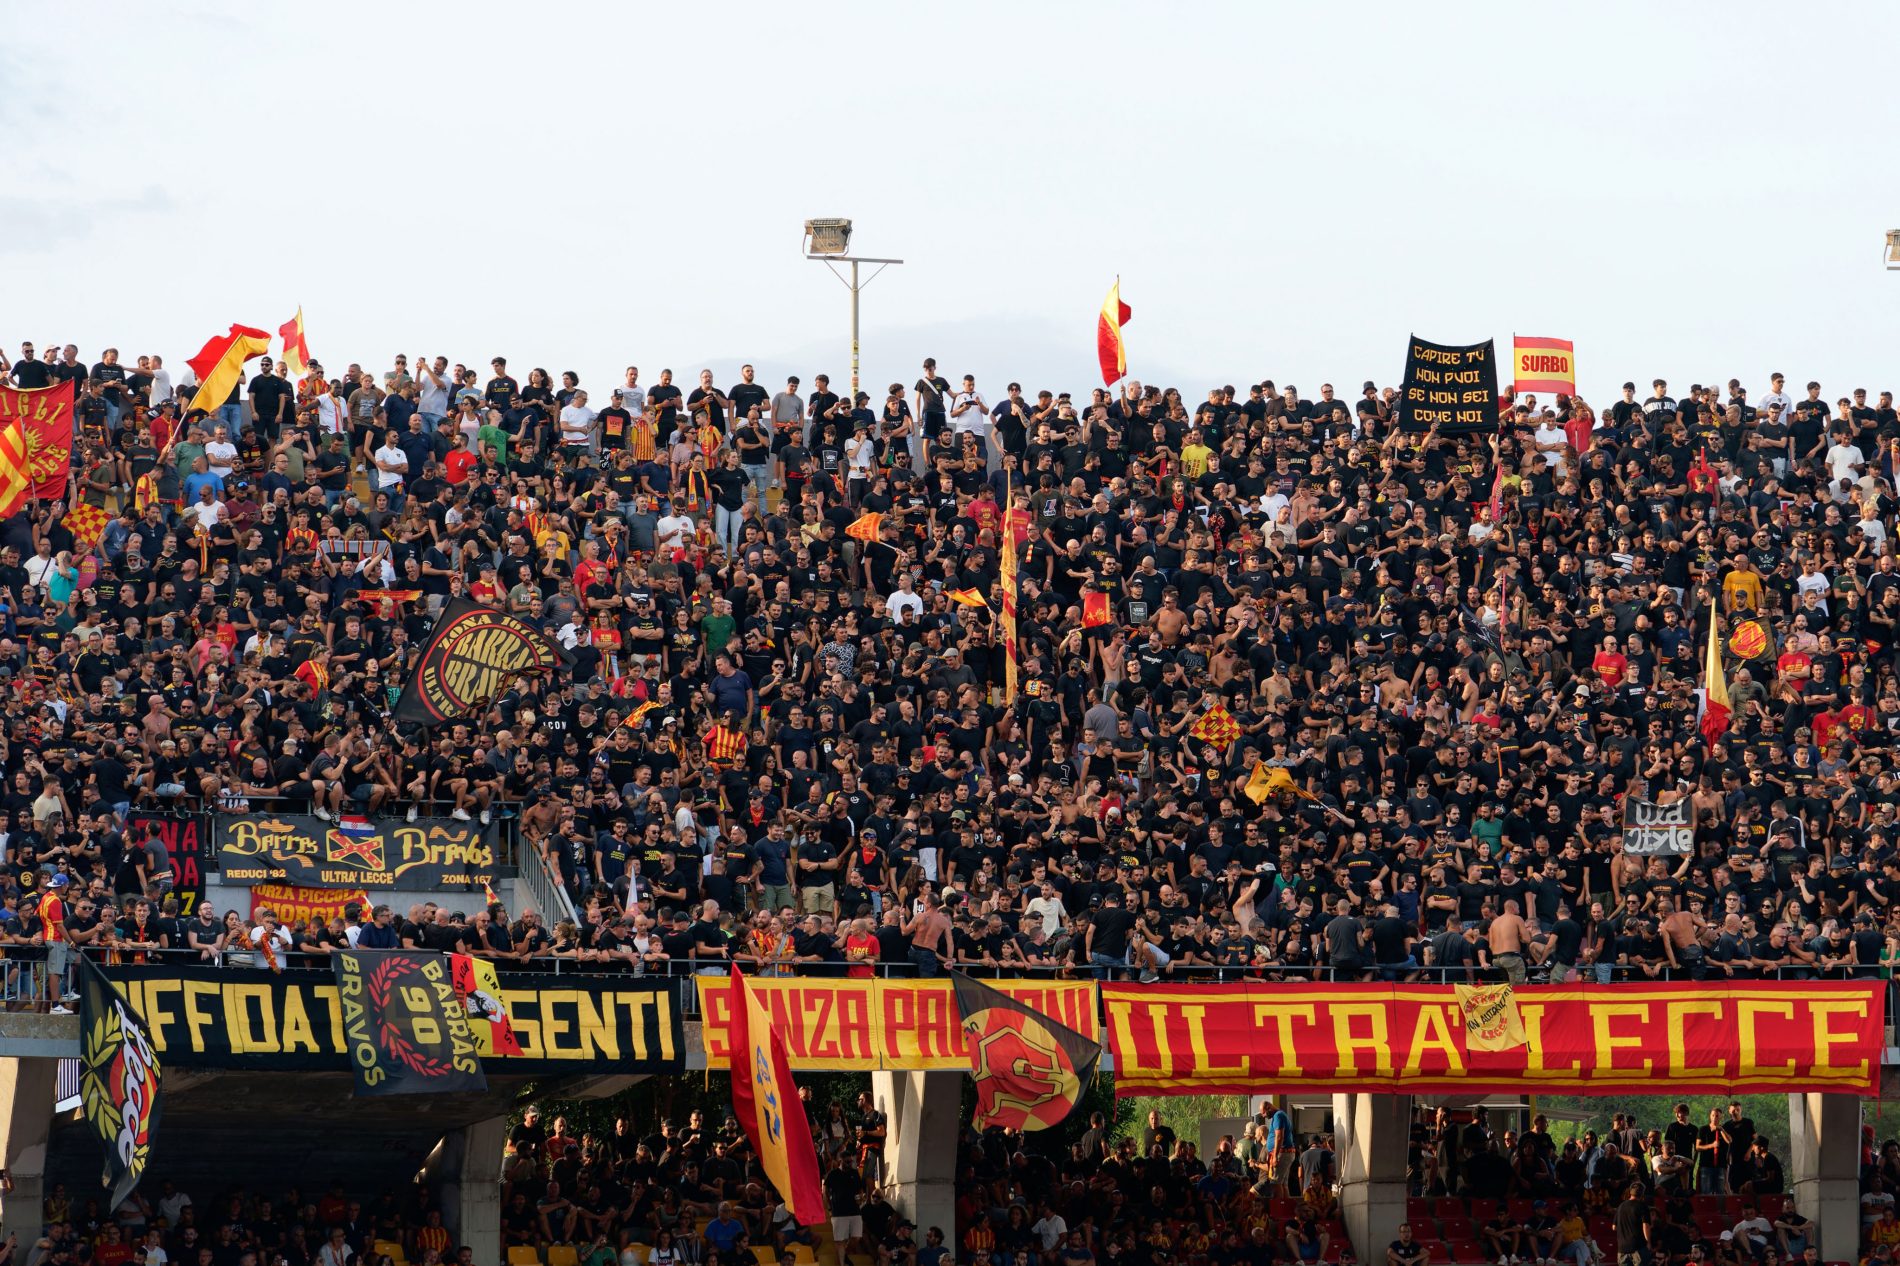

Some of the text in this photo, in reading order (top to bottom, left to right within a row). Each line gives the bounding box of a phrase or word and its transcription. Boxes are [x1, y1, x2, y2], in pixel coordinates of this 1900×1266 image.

[1414, 345, 1460, 365] CAPIRE
[1521, 355, 1568, 373] SURBO
[1416, 367, 1480, 384] NON PUOI
[0, 392, 66, 426] IGLI
[1408, 387, 1489, 404] SE NON SEI
[1414, 409, 1483, 423] COME NOI
[30, 443, 69, 484] OLE
[438, 614, 492, 650] ZONA
[445, 660, 503, 706] BRAV
[226, 869, 267, 879] REDUCI
[321, 870, 394, 885] ULTRA' LECCE
[441, 874, 493, 885] ZONA 167
[298, 887, 366, 904] PICCOLA
[110, 979, 675, 1061] IFFIDAT SENTI
[340, 953, 386, 1087] BRAVOS
[400, 986, 443, 1045] 90
[422, 959, 477, 1075] BARRAS
[703, 988, 876, 1059] SNZA
[1109, 1000, 1870, 1079] ULTRA' LECCE
[115, 1000, 152, 1168] Lecce
